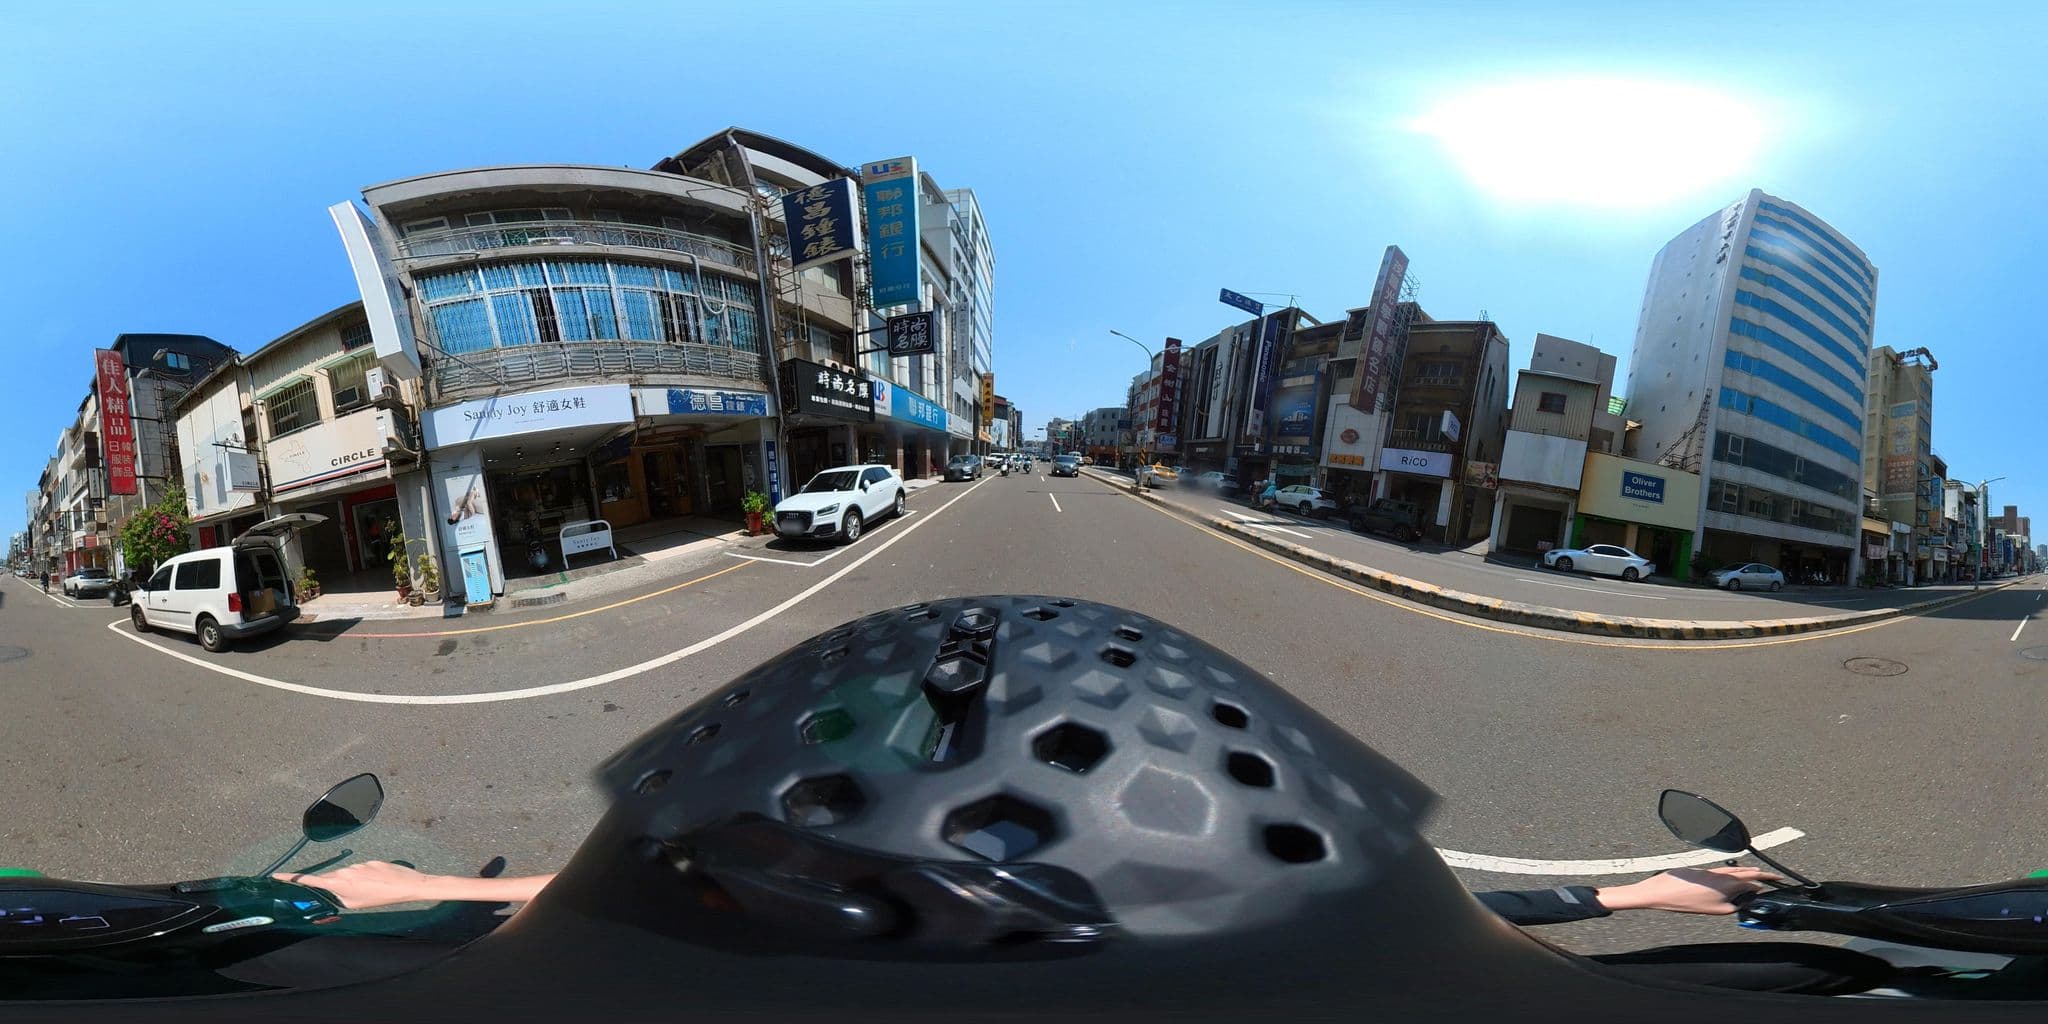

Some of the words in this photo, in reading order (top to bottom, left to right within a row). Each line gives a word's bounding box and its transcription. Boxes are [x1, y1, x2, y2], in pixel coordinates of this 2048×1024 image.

[794, 186, 844, 259] 德昌鐘錶
[876, 188, 905, 260] 聯邦銀行
[893, 316, 928, 334] 時尚
[102, 359, 127, 436] 佳人精品
[506, 402, 527, 418] Joy
[533, 396, 586, 414] 舒適女鞋
[331, 448, 375, 467] CIRCLE
[1632, 476, 1656, 487] Oliver
[1624, 485, 1661, 499] Brothers
